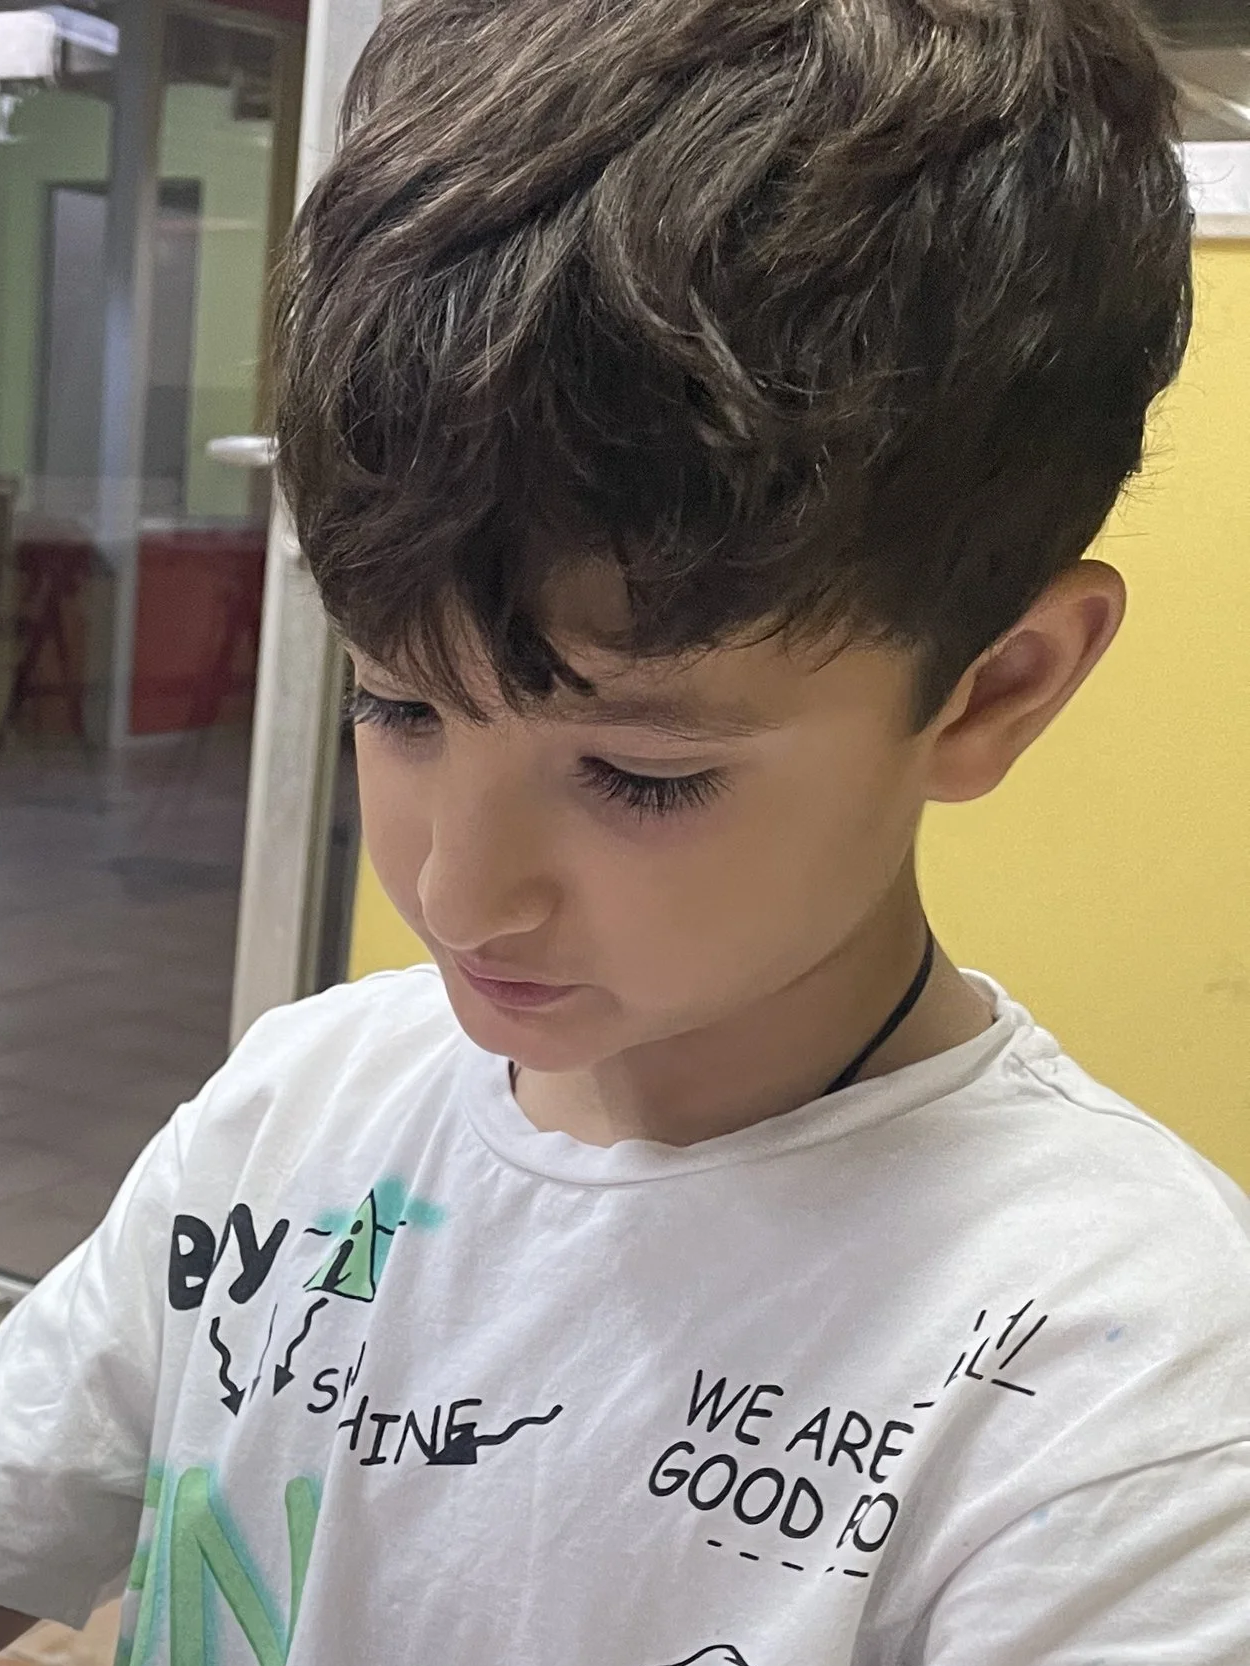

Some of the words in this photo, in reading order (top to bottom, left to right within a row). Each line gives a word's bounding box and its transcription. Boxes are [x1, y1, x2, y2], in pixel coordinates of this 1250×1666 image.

[686, 1369, 784, 1446] WE
[785, 1406, 915, 1484] ARE
[648, 1440, 824, 1539] GOOD
